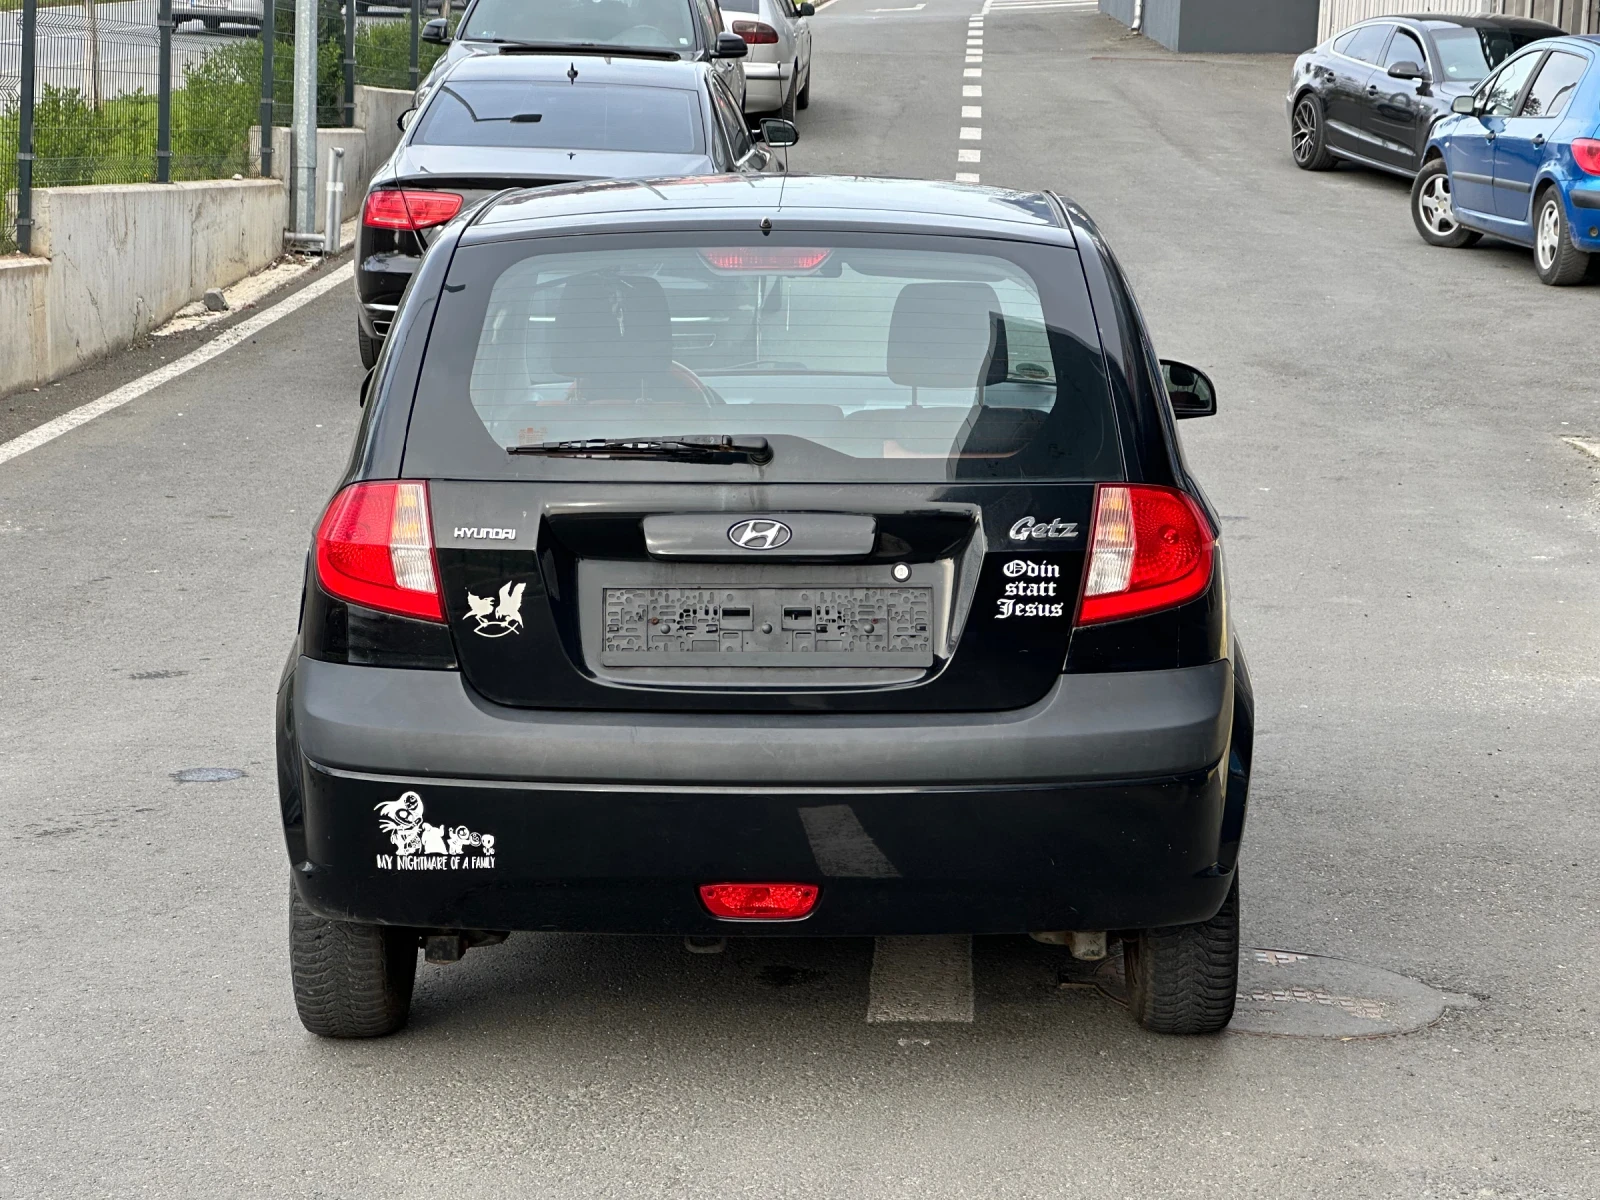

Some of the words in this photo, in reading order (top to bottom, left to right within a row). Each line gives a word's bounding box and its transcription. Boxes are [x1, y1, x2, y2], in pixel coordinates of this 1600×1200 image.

[454, 527, 516, 540] HYUNDAI
[1009, 515, 1079, 541] Getz
[1003, 559, 1061, 578] Odin
[1004, 580, 1057, 597] statt
[994, 598, 1065, 619] Jesus
[376, 853, 393, 870] MY
[397, 855, 448, 871] NIGHTMARE
[450, 856, 461, 870] OF
[462, 856, 469, 870] A
[471, 856, 496, 869] FAMILY
